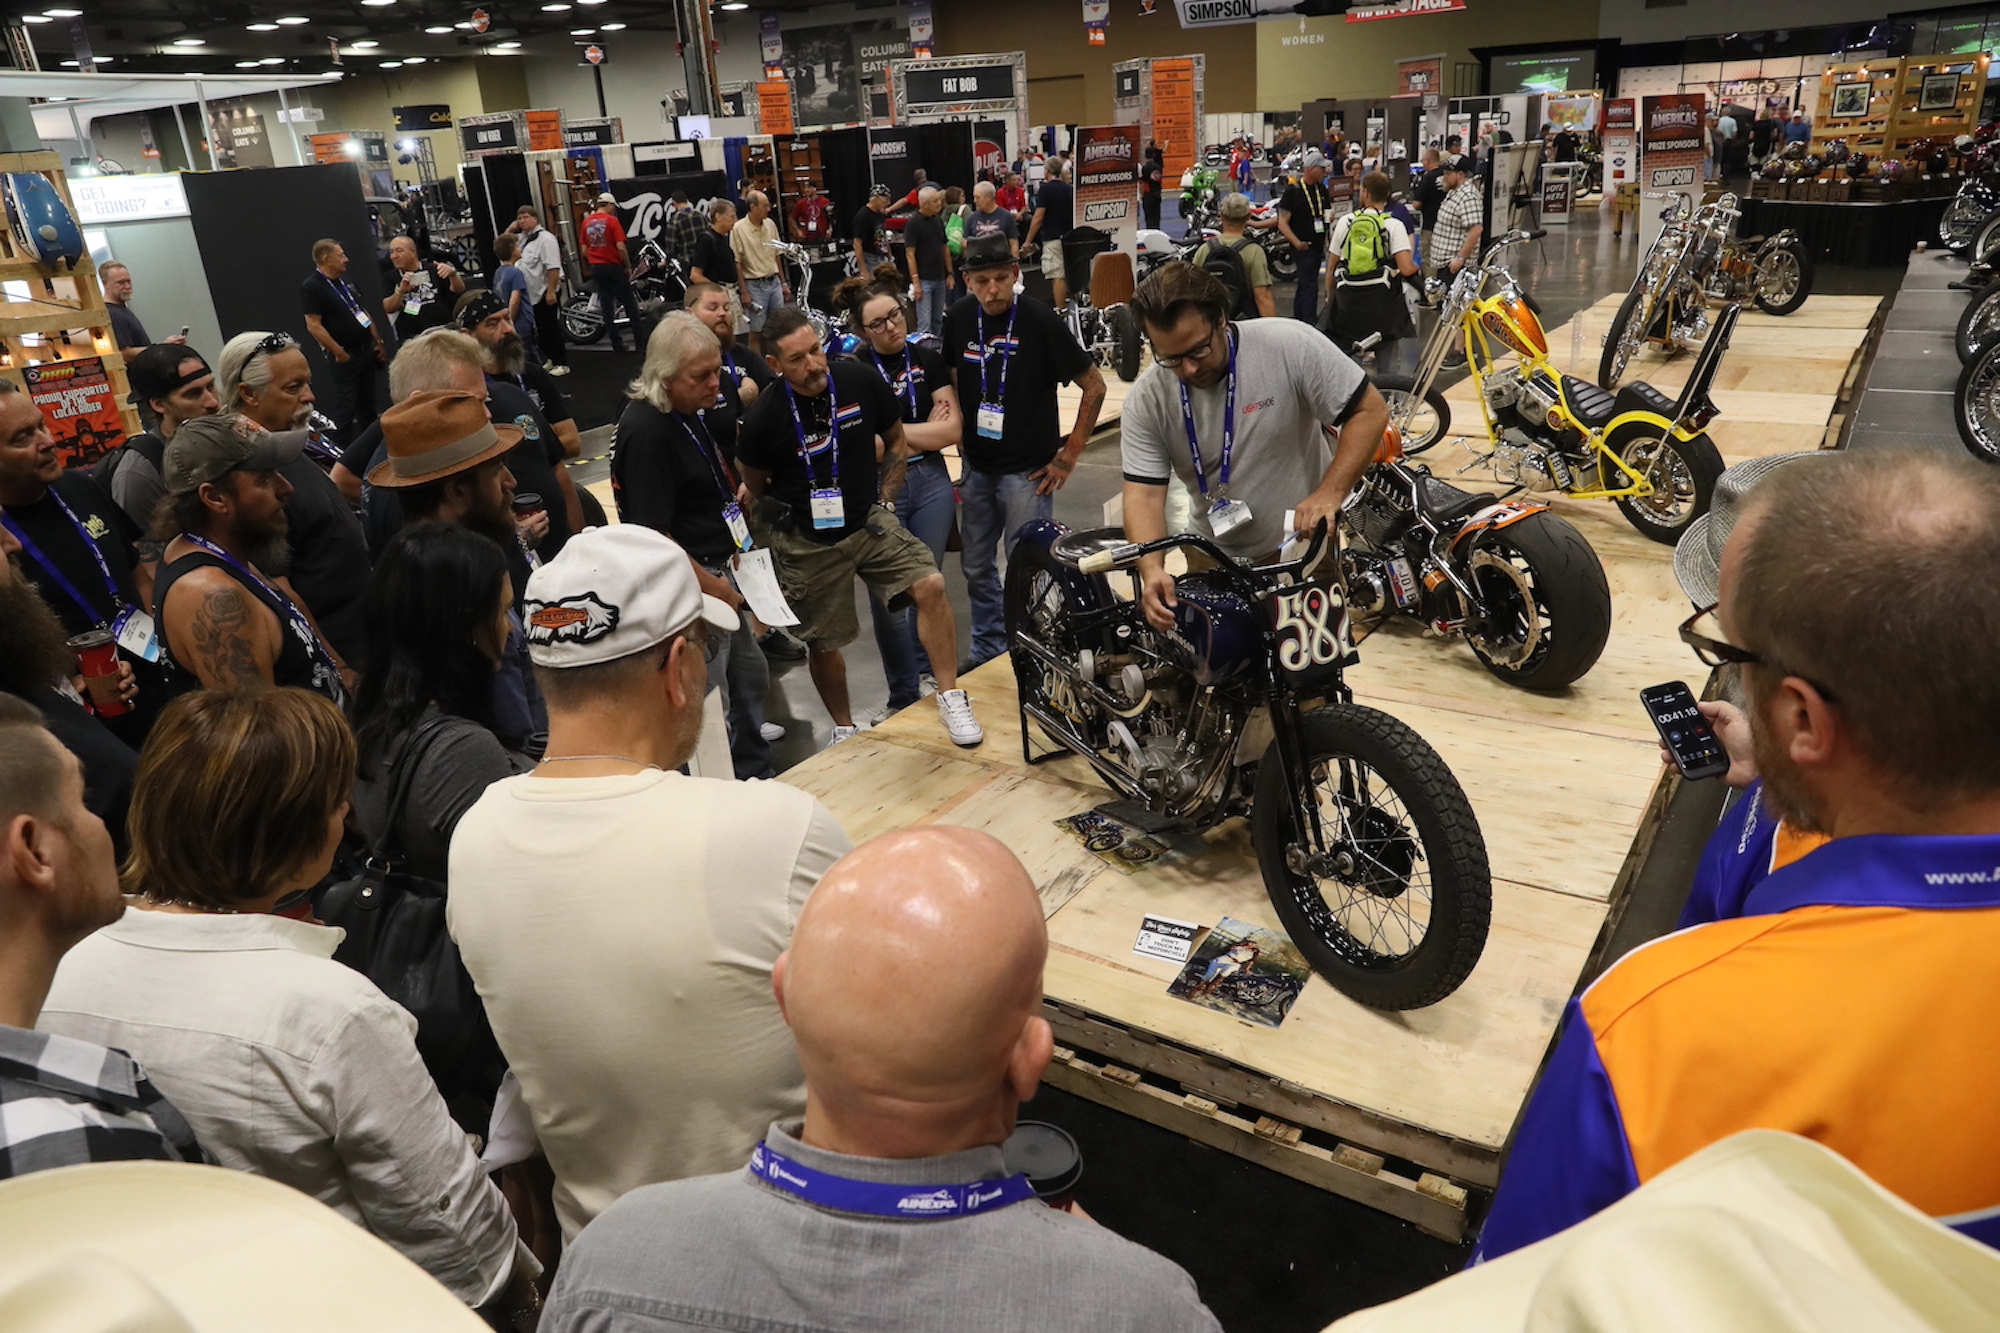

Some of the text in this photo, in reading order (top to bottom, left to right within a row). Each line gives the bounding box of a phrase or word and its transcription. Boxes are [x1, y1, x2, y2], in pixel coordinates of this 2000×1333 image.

[1189, 0, 1251, 20] SIMPSON
[911, 18, 930, 26] 2300
[1281, 34, 1324, 46] WOMEN
[862, 61, 890, 73] EATS
[942, 77, 977, 93] FAT BOB
[1651, 111, 1698, 128] AMERICAS
[871, 141, 907, 155] ANDREWS
[1648, 138, 1699, 151] PRIZE SPONSORS
[1084, 144, 1131, 161] AMERICAS
[1081, 171, 1132, 184] PRIZE SPONSORS
[1653, 168, 1694, 187] SIMPSON
[80, 187, 106, 200] GET
[1545, 183, 1564, 193] VOTE
[1544, 192, 1566, 201] HERE
[94, 198, 147, 215] GOING?
[1086, 201, 1126, 220] SIMPSON
[32, 384, 110, 406] PROUD SUPPORTER
[60, 396, 88, 409] OF THE
[1242, 397, 1275, 414] LIGHTSHOE
[52, 402, 103, 420] LOCAL RIDER
[1276, 582, 1357, 671] 582
[1658, 706, 1699, 724] 00:41.18
[1153, 940, 1173, 950] TOUCH
[1161, 937, 1180, 946] DON'T
[1147, 945, 1186, 958] MOTORCYCLE
